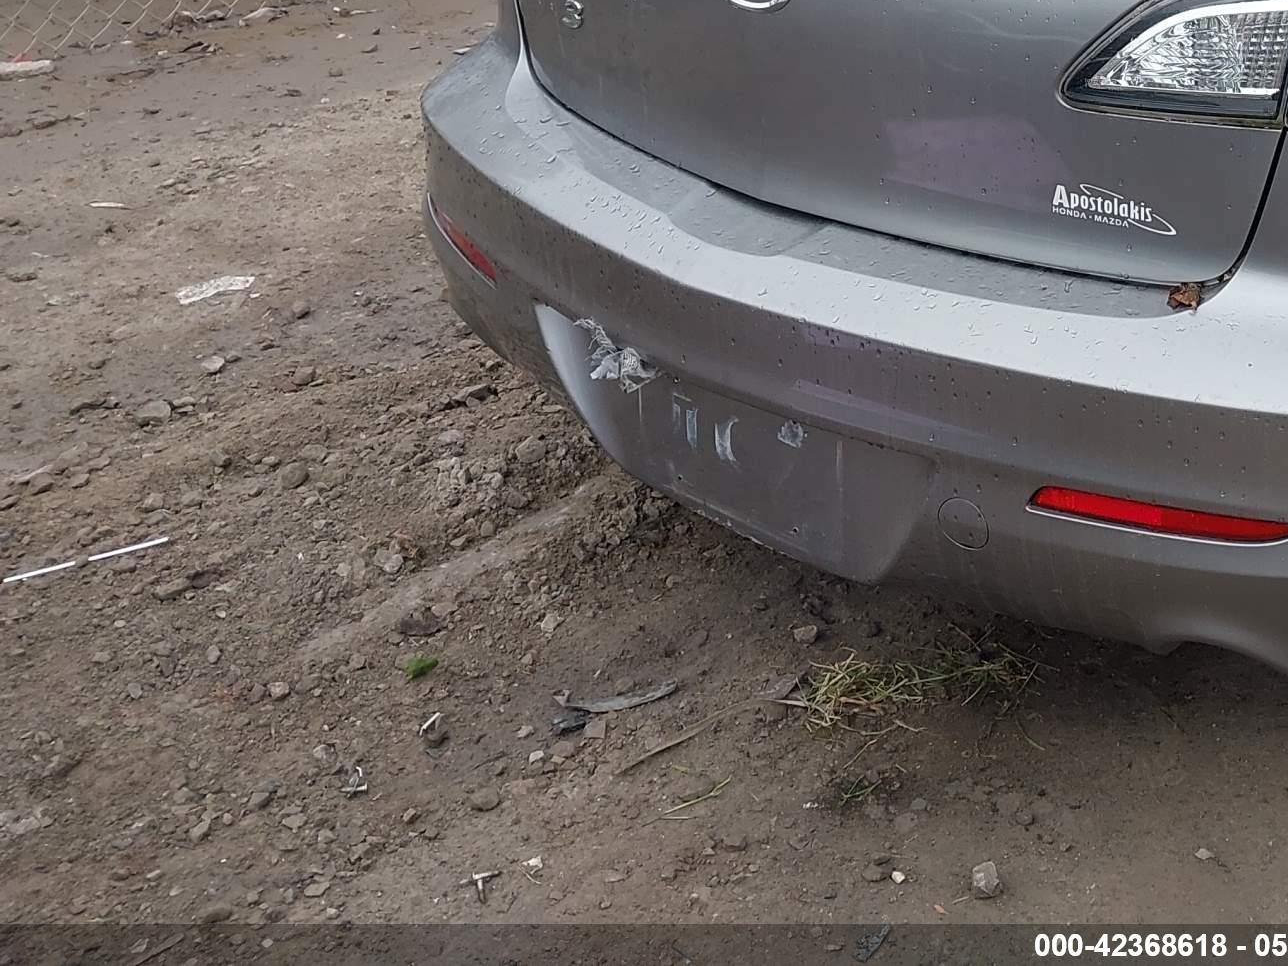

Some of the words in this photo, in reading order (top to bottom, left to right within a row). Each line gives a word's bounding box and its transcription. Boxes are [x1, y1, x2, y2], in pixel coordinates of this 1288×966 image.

[1052, 184, 1153, 222] Apostolakis
[1052, 206, 1088, 220] HONDA
[1093, 214, 1129, 228] MAZDA
